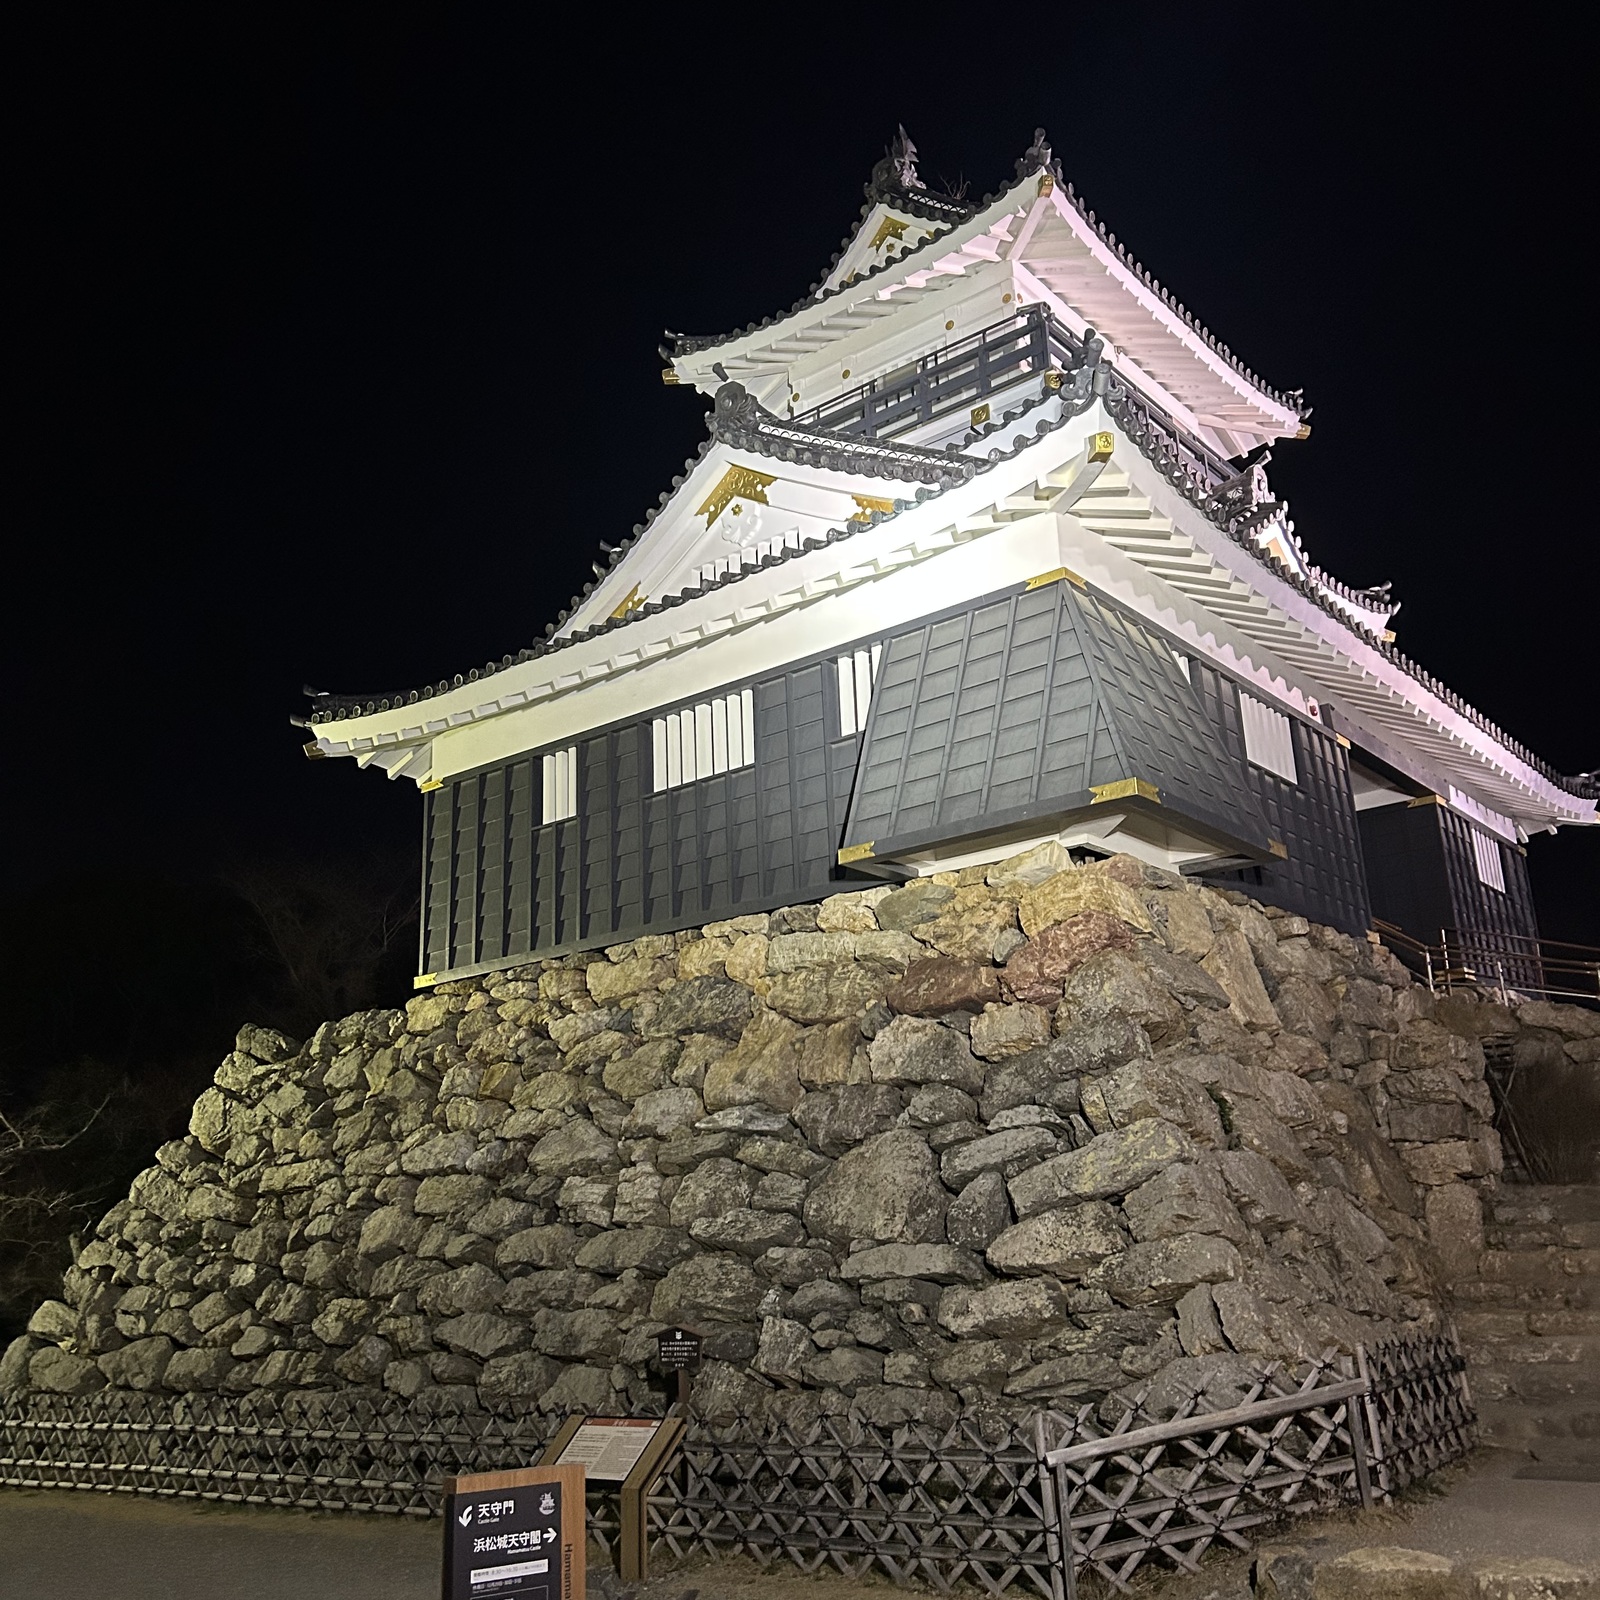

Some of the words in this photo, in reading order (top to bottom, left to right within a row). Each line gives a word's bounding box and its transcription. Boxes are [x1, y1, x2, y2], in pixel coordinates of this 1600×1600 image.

[478, 1500, 515, 1518] 天守門
[473, 1530, 542, 1553] 浜松城天守閣
